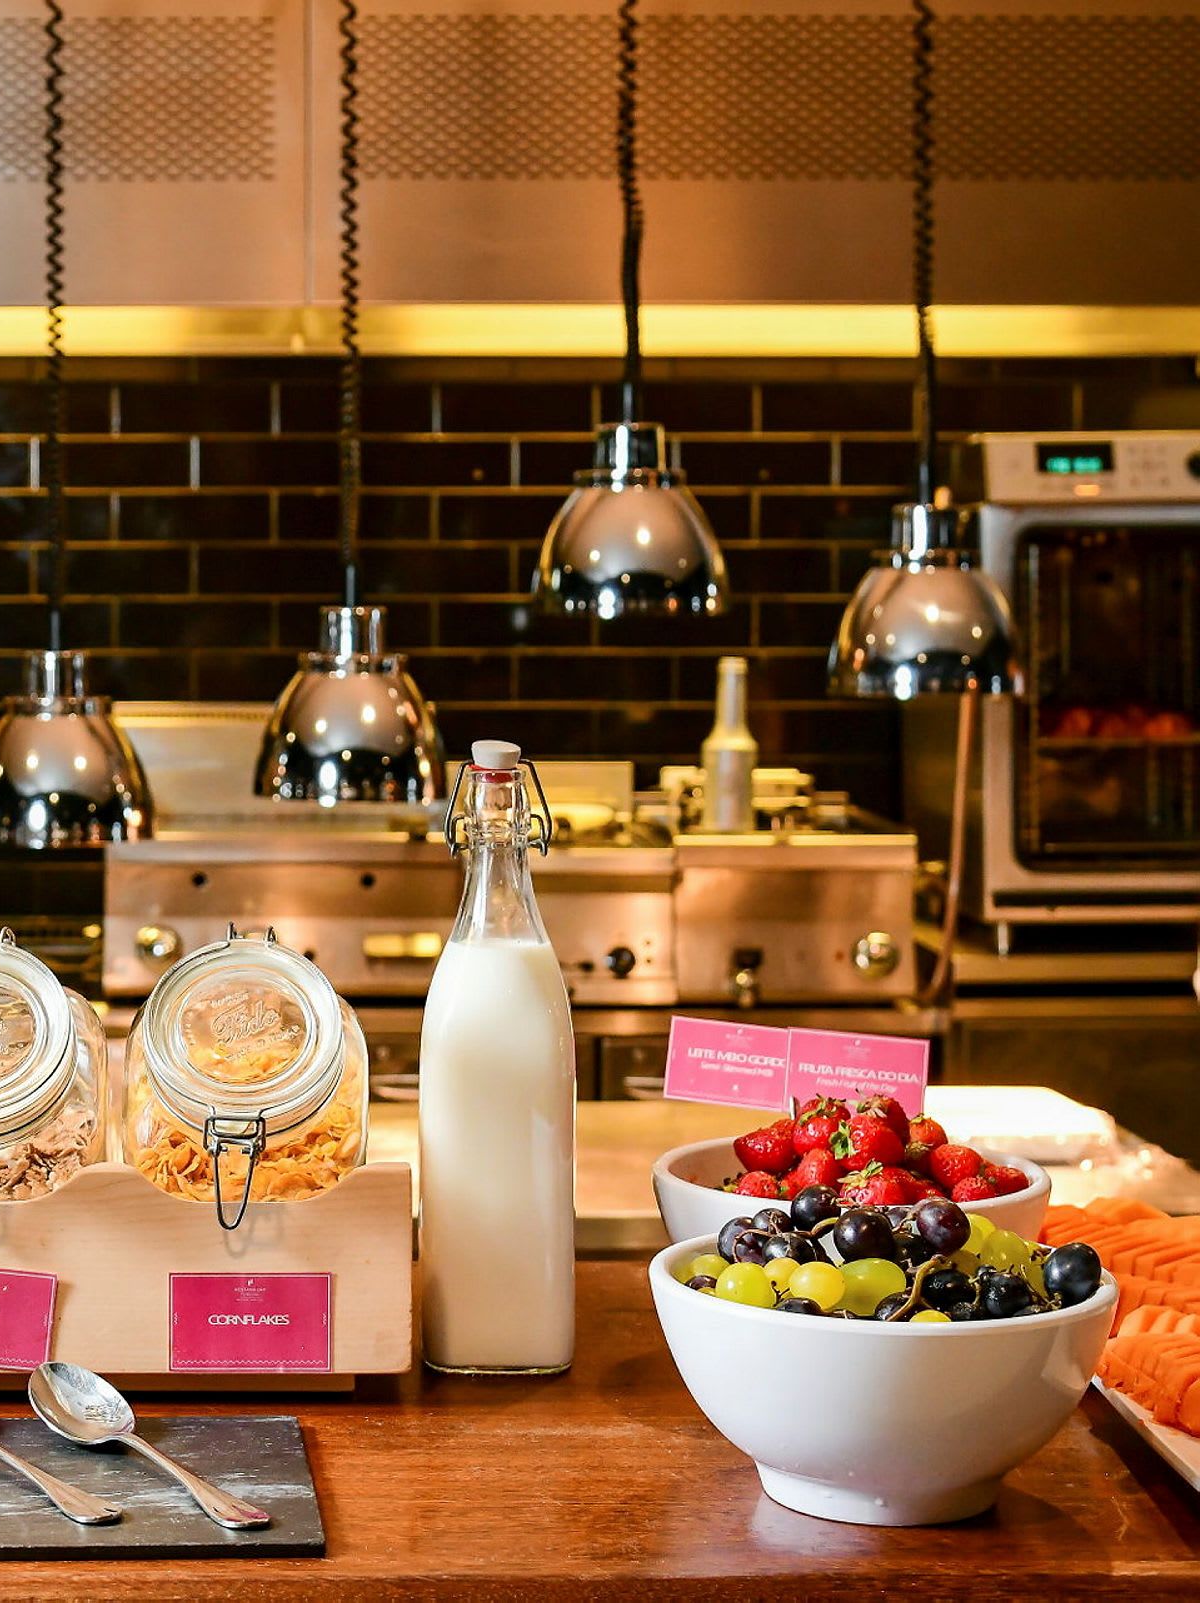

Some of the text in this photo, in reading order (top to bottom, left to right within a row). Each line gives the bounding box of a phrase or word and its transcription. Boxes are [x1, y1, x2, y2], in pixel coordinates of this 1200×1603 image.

[799, 1062, 833, 1075] FRUTA
[835, 1066, 877, 1080] FRESCA
[878, 1071, 896, 1081] DO
[208, 1313, 290, 1326] CORNFLAKES
